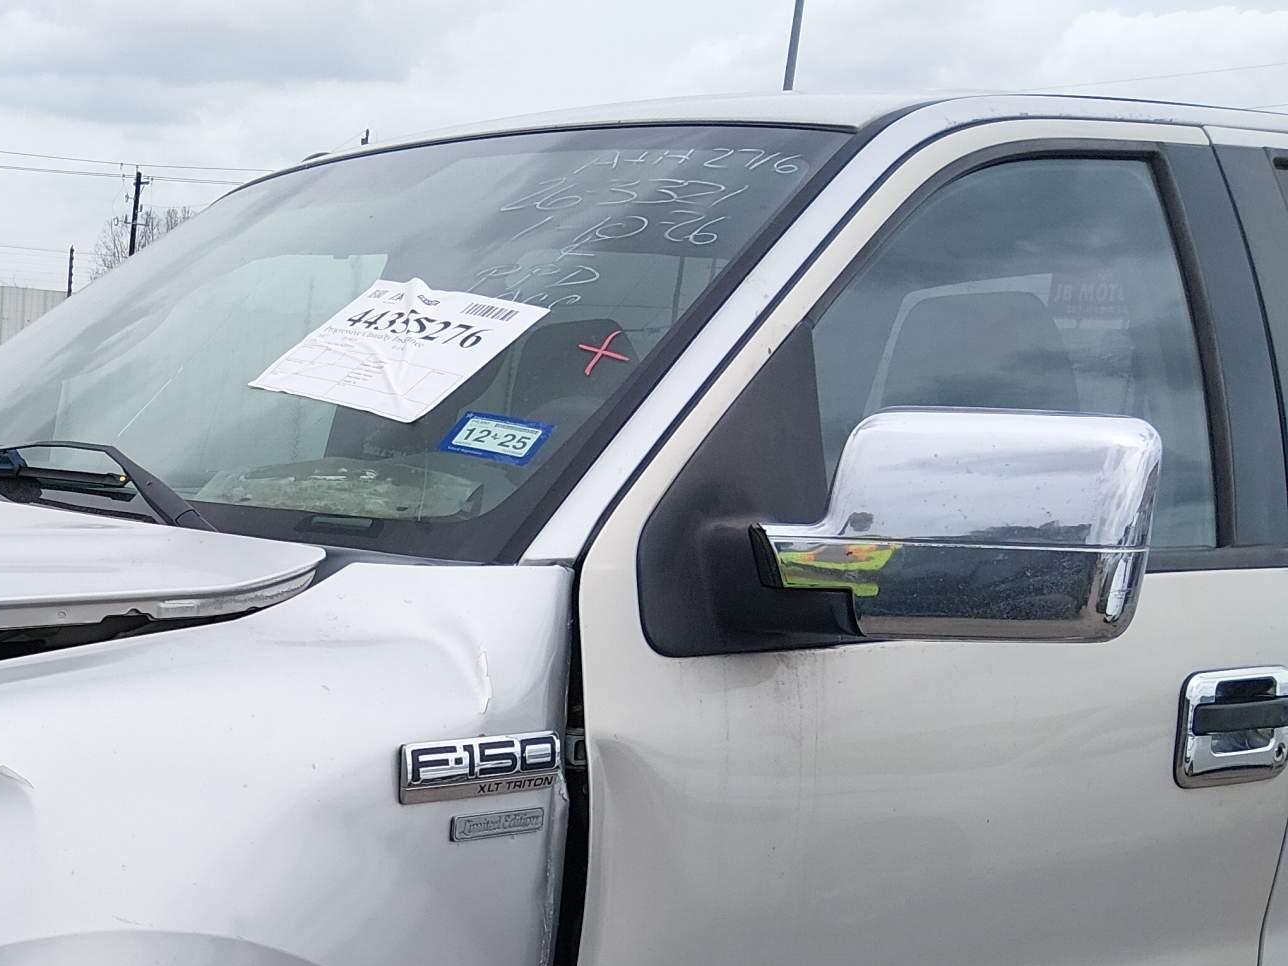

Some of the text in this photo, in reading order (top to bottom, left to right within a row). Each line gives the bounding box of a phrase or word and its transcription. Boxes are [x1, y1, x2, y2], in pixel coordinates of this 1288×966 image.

[346, 308, 496, 349] 44355276
[463, 427, 531, 450] 12 25
[477, 775, 554, 794] XLT TRITON
[459, 812, 540, 837] Limited Edition
